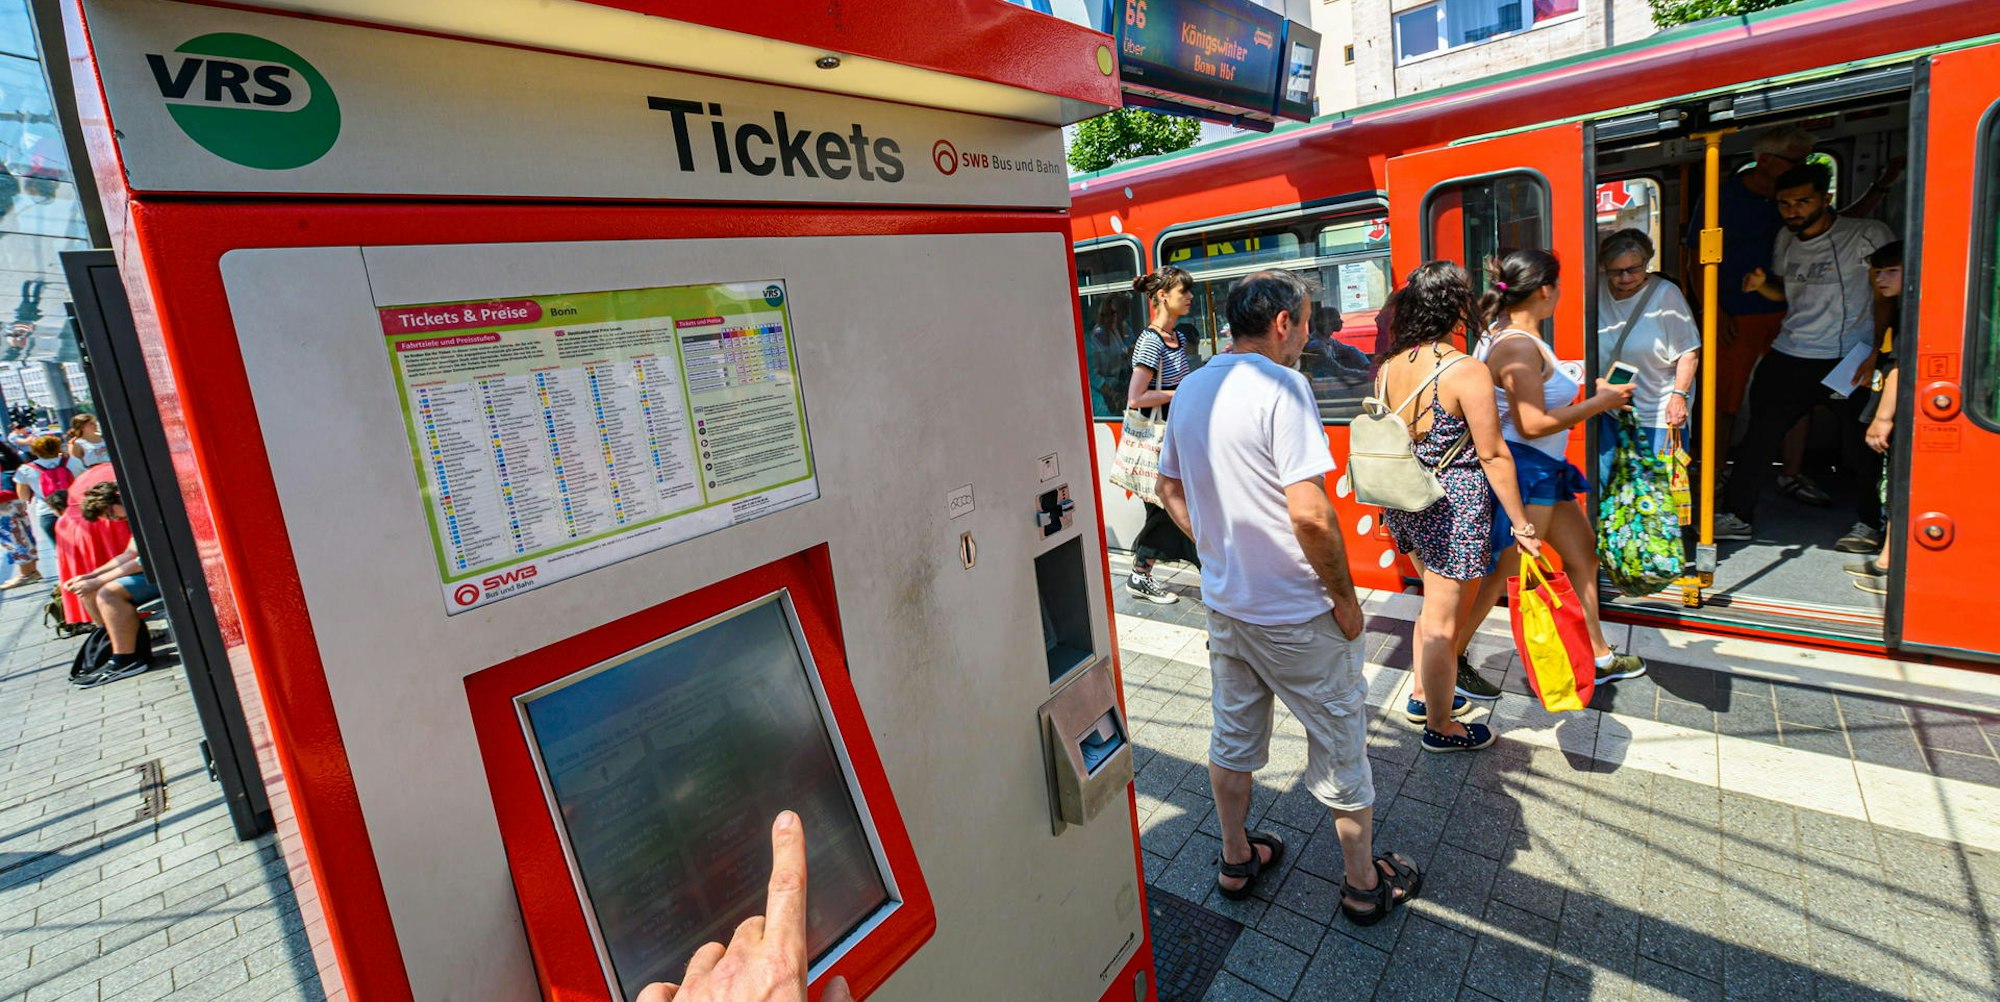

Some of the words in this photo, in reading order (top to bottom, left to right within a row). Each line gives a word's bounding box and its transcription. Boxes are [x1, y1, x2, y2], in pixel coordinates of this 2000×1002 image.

[1124, 0, 1147, 29] 66
[1123, 37, 1146, 56] über
[1181, 21, 1248, 62] Königswinter
[1193, 54, 1216, 75] Bonn
[1219, 62, 1237, 81] Hbf
[145, 53, 292, 106] VRS
[647, 95, 905, 183] Tickets
[962, 152, 989, 169] SWB
[992, 155, 1012, 171] Bus
[1014, 158, 1034, 172] und
[1036, 159, 1060, 174] Bahn
[762, 289, 779, 298] VRS
[398, 311, 460, 328] Tickets
[463, 309, 478, 323] &
[481, 306, 528, 321] Preise
[550, 307, 577, 317] Bonn
[401, 339, 439, 349] Fahrtziele
[440, 337, 455, 346] und
[456, 334, 496, 344] Preisstufen
[482, 565, 538, 591] SWB
[485, 590, 499, 599] Bus
[500, 584, 515, 594] und
[516, 579, 534, 590] Bahn
